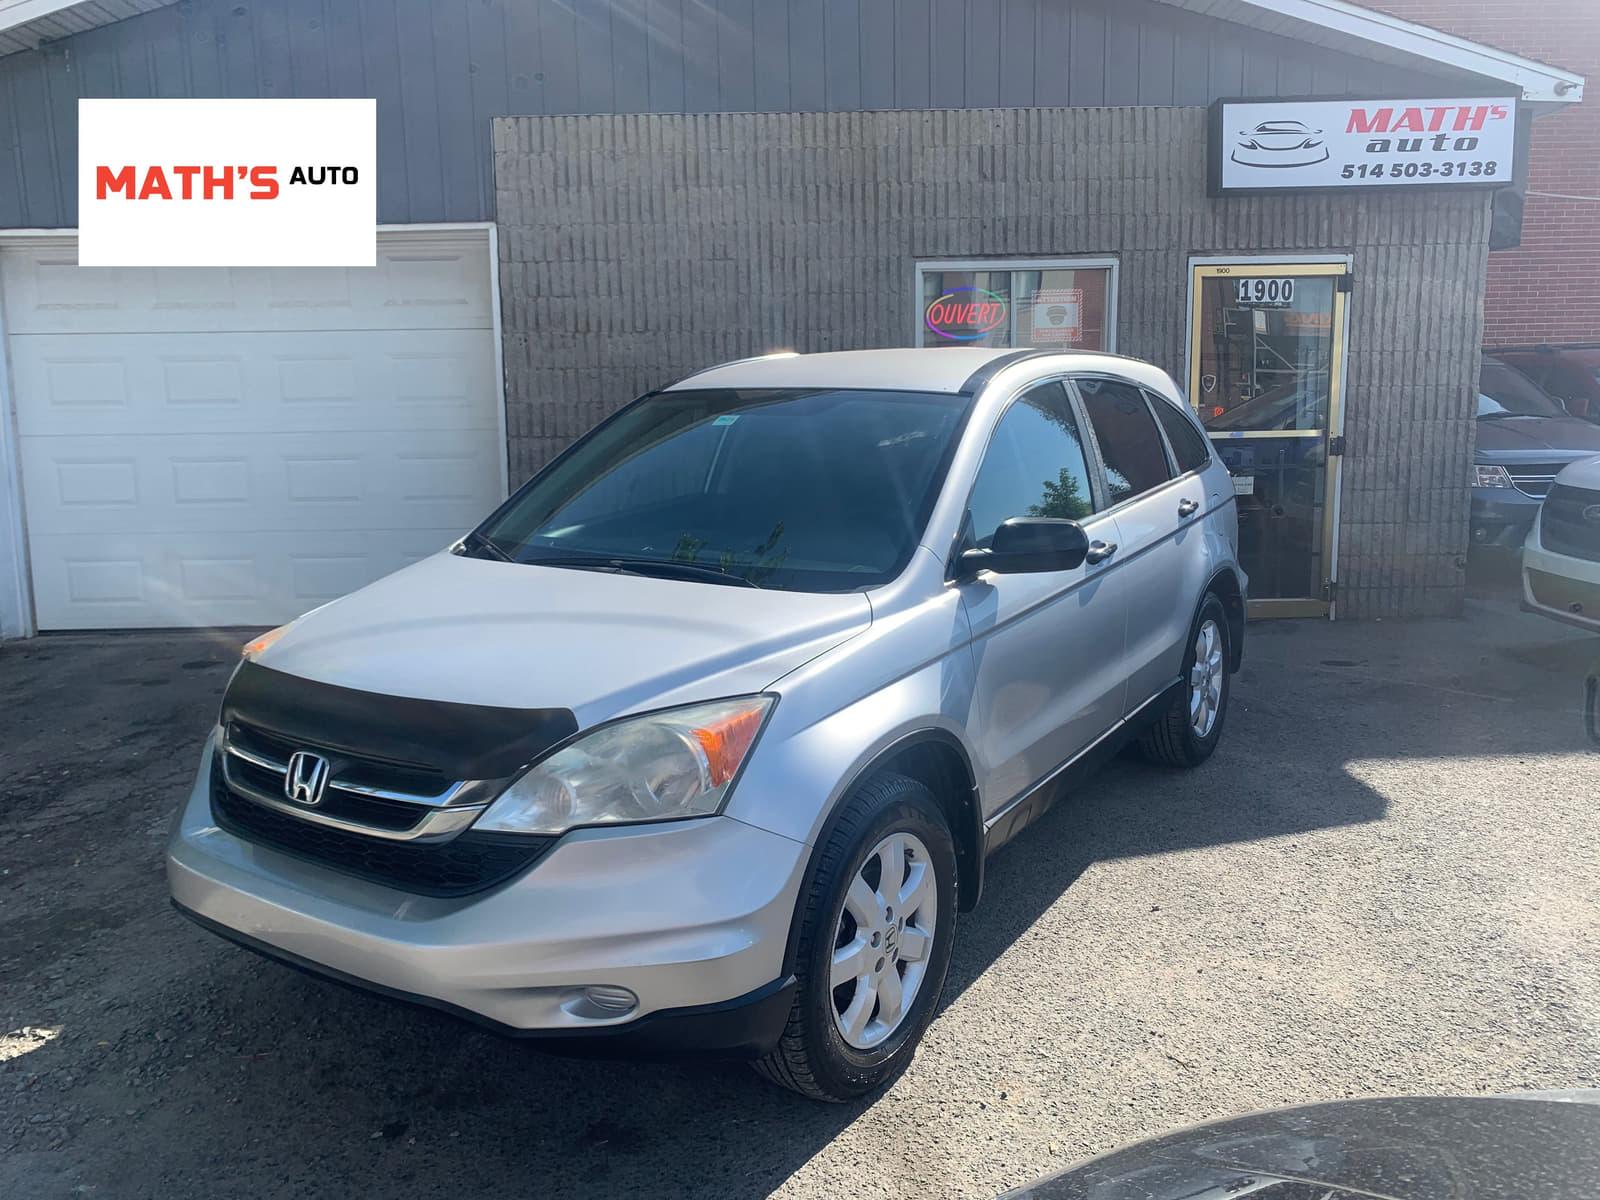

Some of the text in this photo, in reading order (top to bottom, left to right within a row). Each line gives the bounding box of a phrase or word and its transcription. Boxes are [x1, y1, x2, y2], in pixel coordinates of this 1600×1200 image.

[1366, 133, 1479, 153] auto
[1340, 161, 1497, 179] 514 503-3138
[1240, 280, 1293, 301] 1900
[930, 303, 1000, 325] OUVERT
